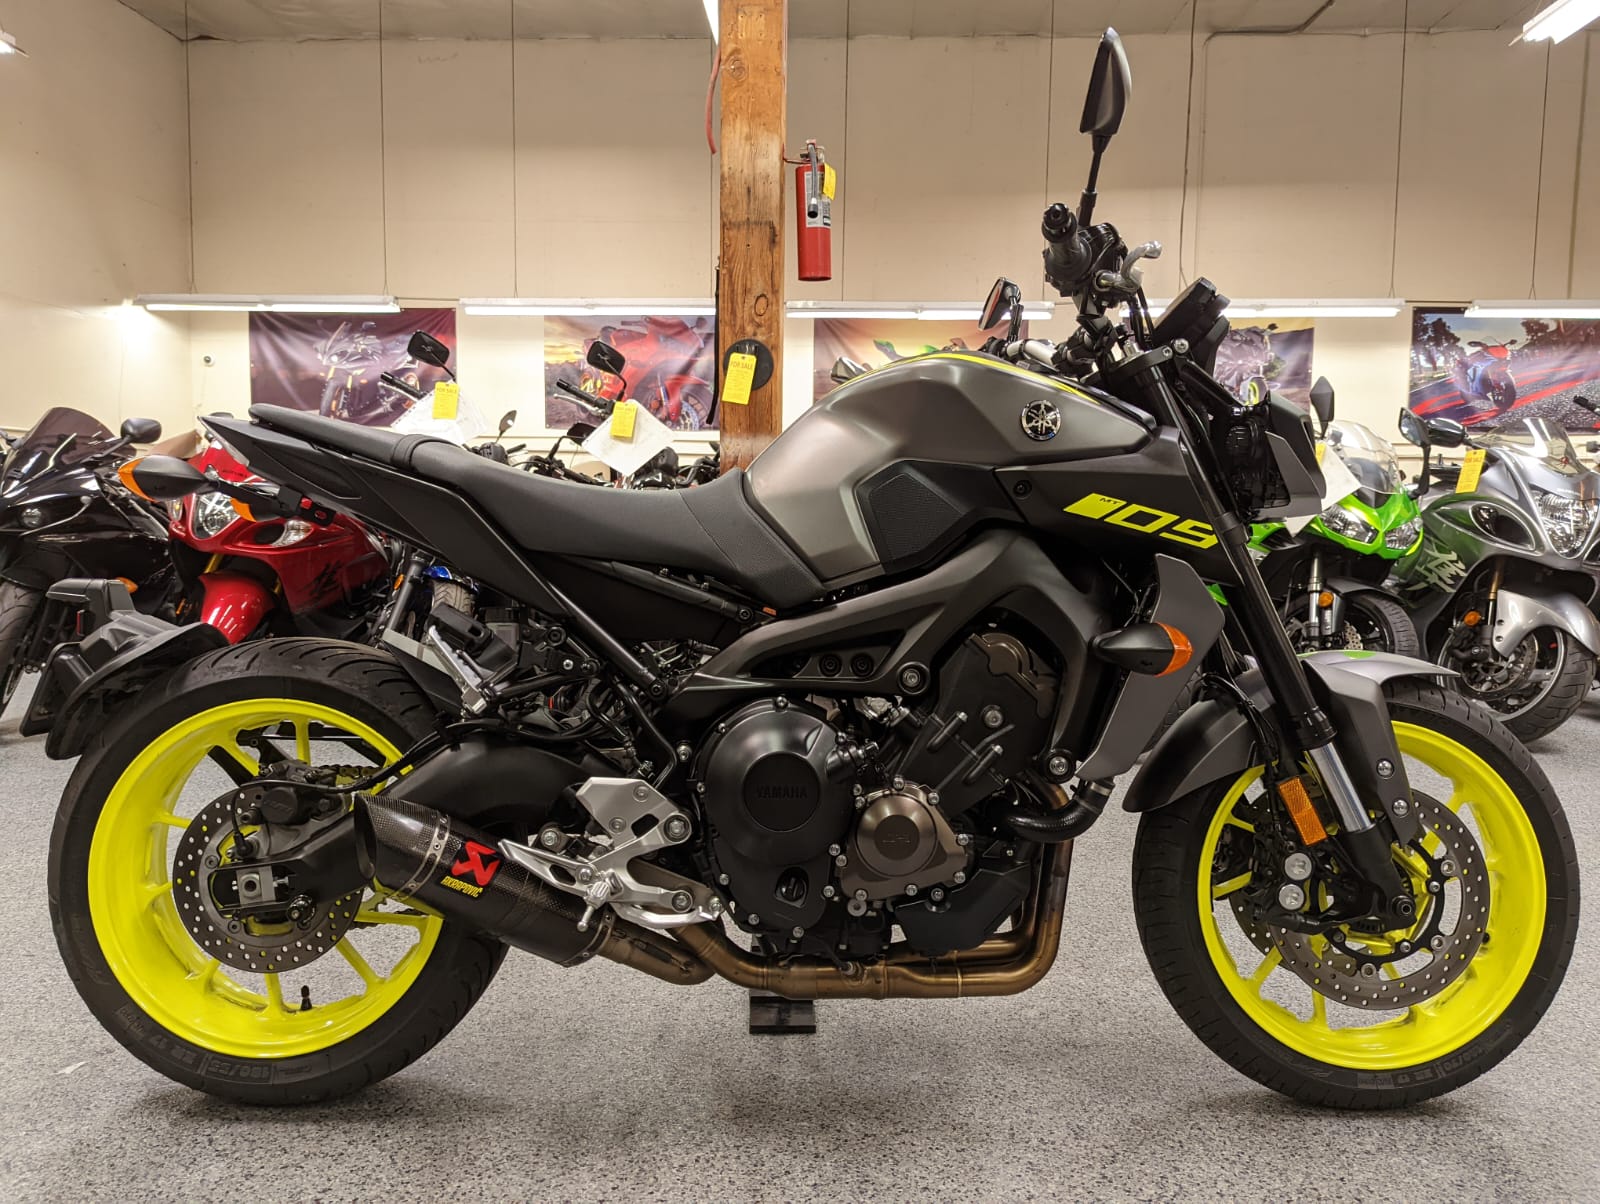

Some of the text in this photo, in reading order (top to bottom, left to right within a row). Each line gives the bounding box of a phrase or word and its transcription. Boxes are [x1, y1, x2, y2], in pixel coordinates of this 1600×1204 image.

[730, 360, 753, 370] FOR SALE
[1099, 497, 1120, 505] MT
[756, 784, 808, 800] YAMAHA
